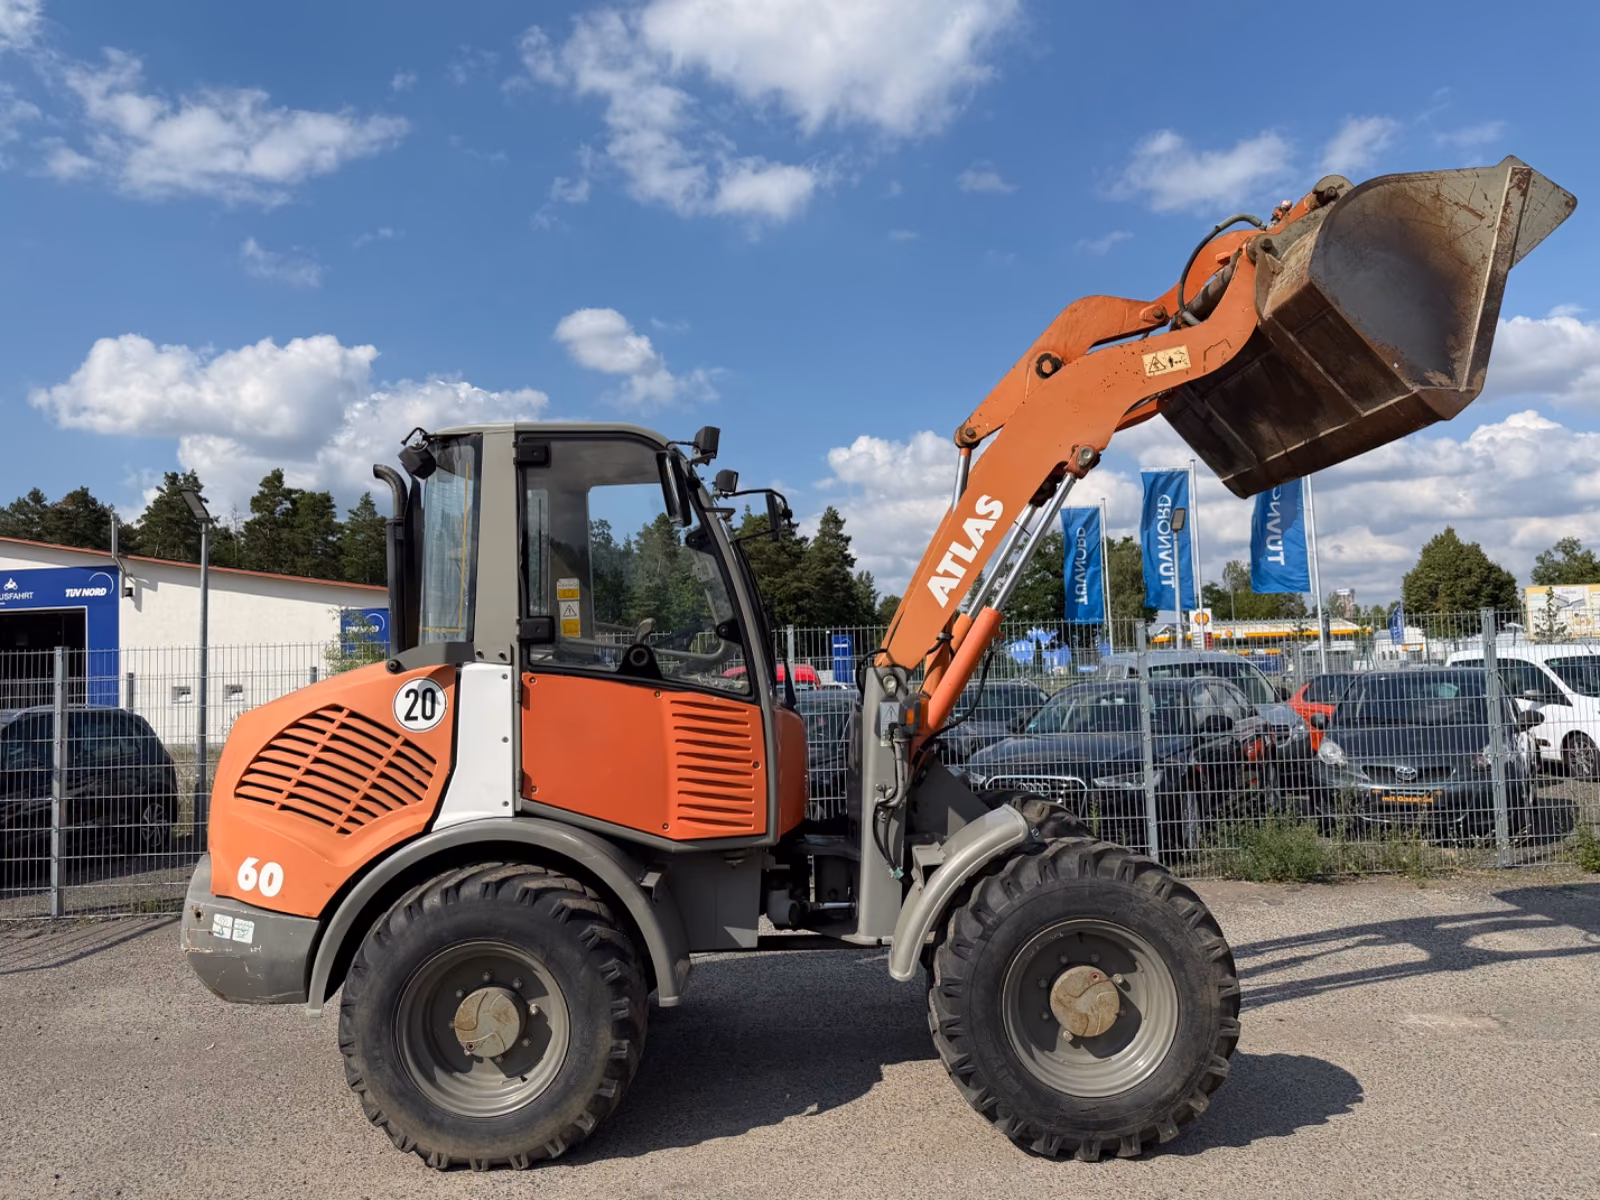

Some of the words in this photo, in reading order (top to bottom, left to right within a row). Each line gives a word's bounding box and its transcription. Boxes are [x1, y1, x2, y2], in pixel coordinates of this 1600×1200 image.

[927, 494, 1004, 608] ATLAS
[81, 587, 107, 597] NORD
[404, 687, 436, 721] 20
[237, 856, 284, 897] 60
